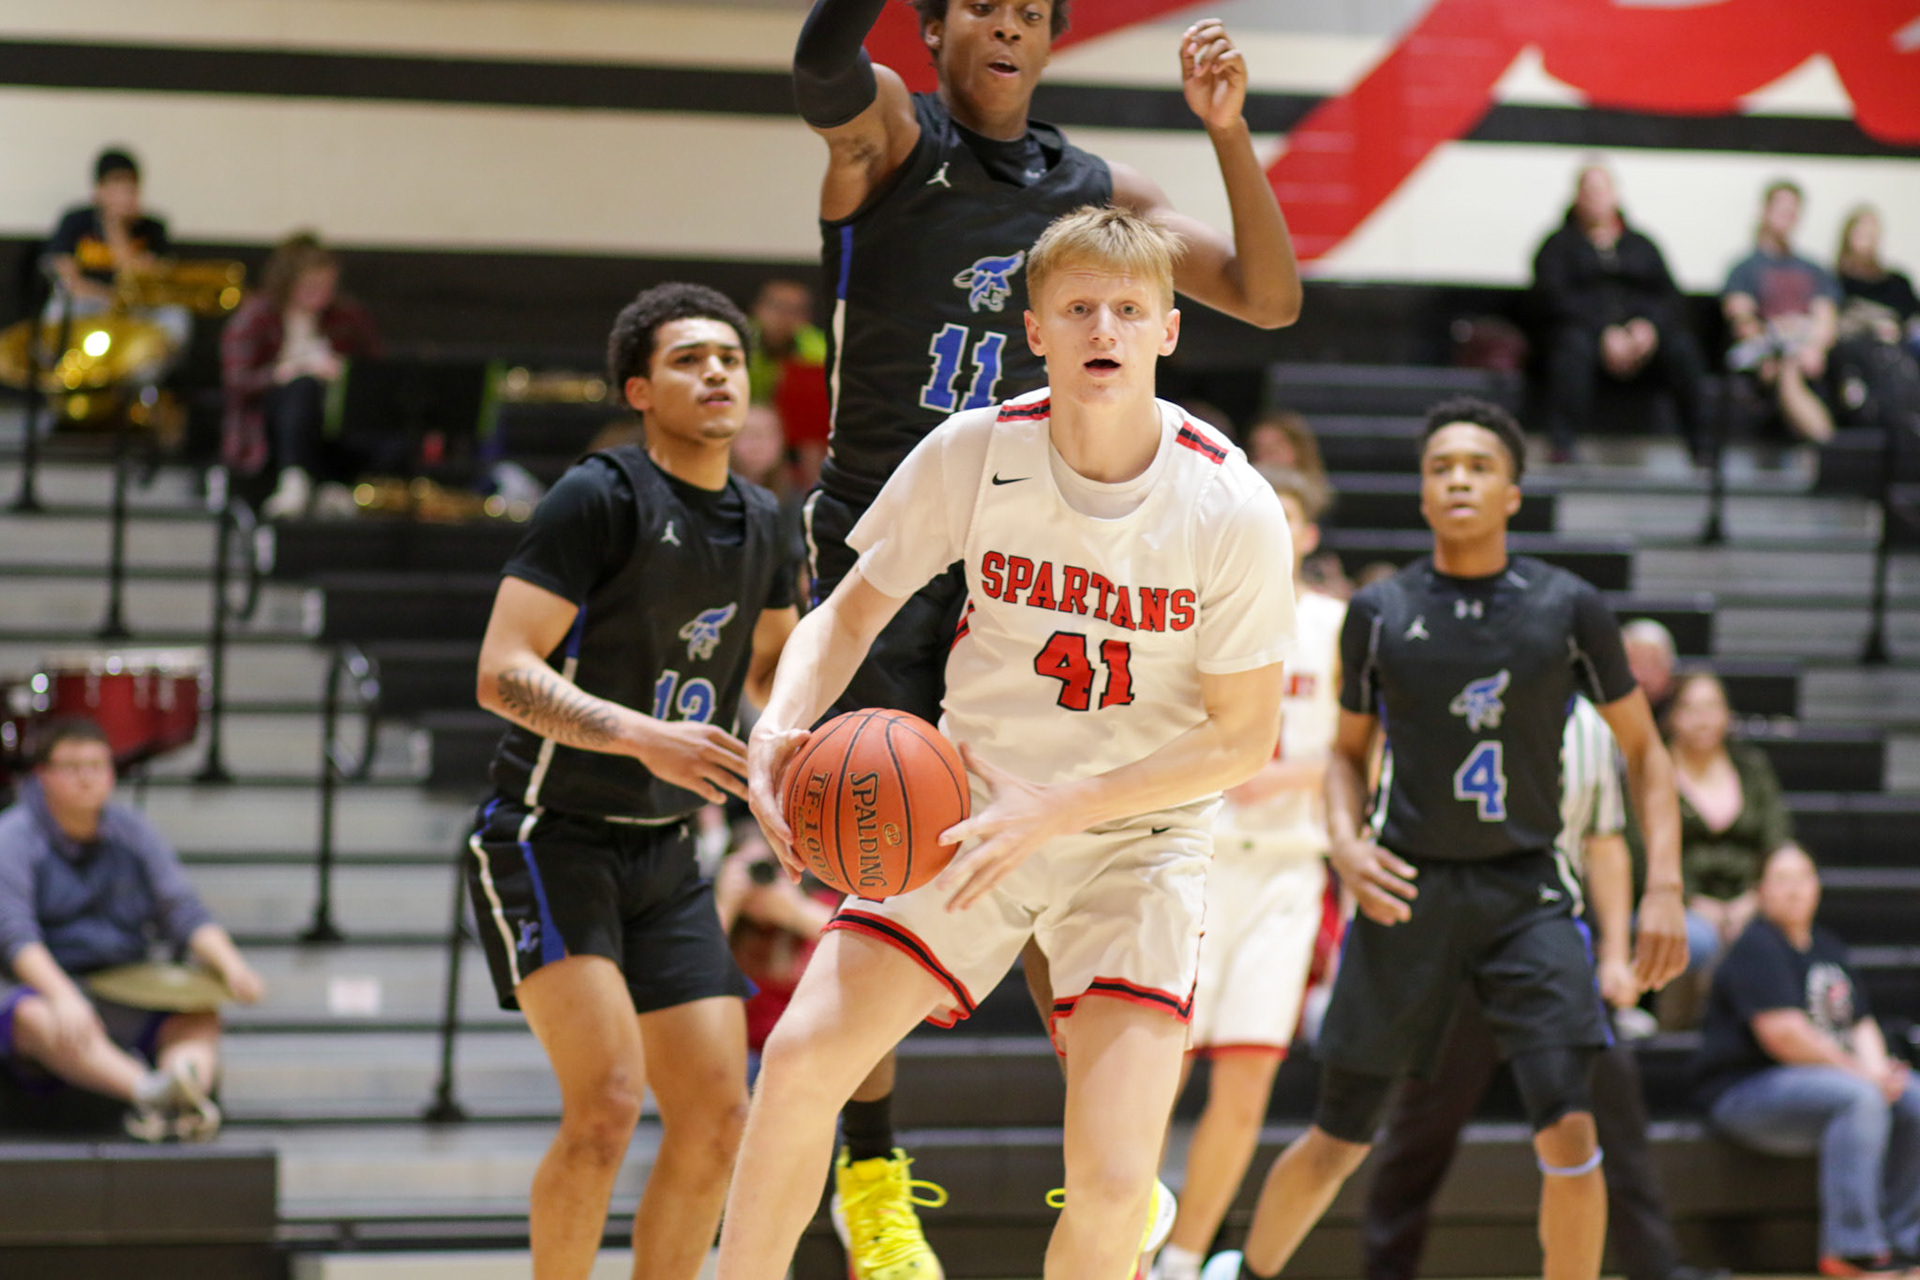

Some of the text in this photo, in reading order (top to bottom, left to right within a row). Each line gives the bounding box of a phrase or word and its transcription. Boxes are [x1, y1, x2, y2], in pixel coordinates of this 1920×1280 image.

[919, 322, 1007, 413] 11
[981, 550, 1196, 632] SPARTANS
[1034, 630, 1135, 711] 41
[1453, 740, 1508, 822] 4
[850, 771, 888, 888] SPALDING
